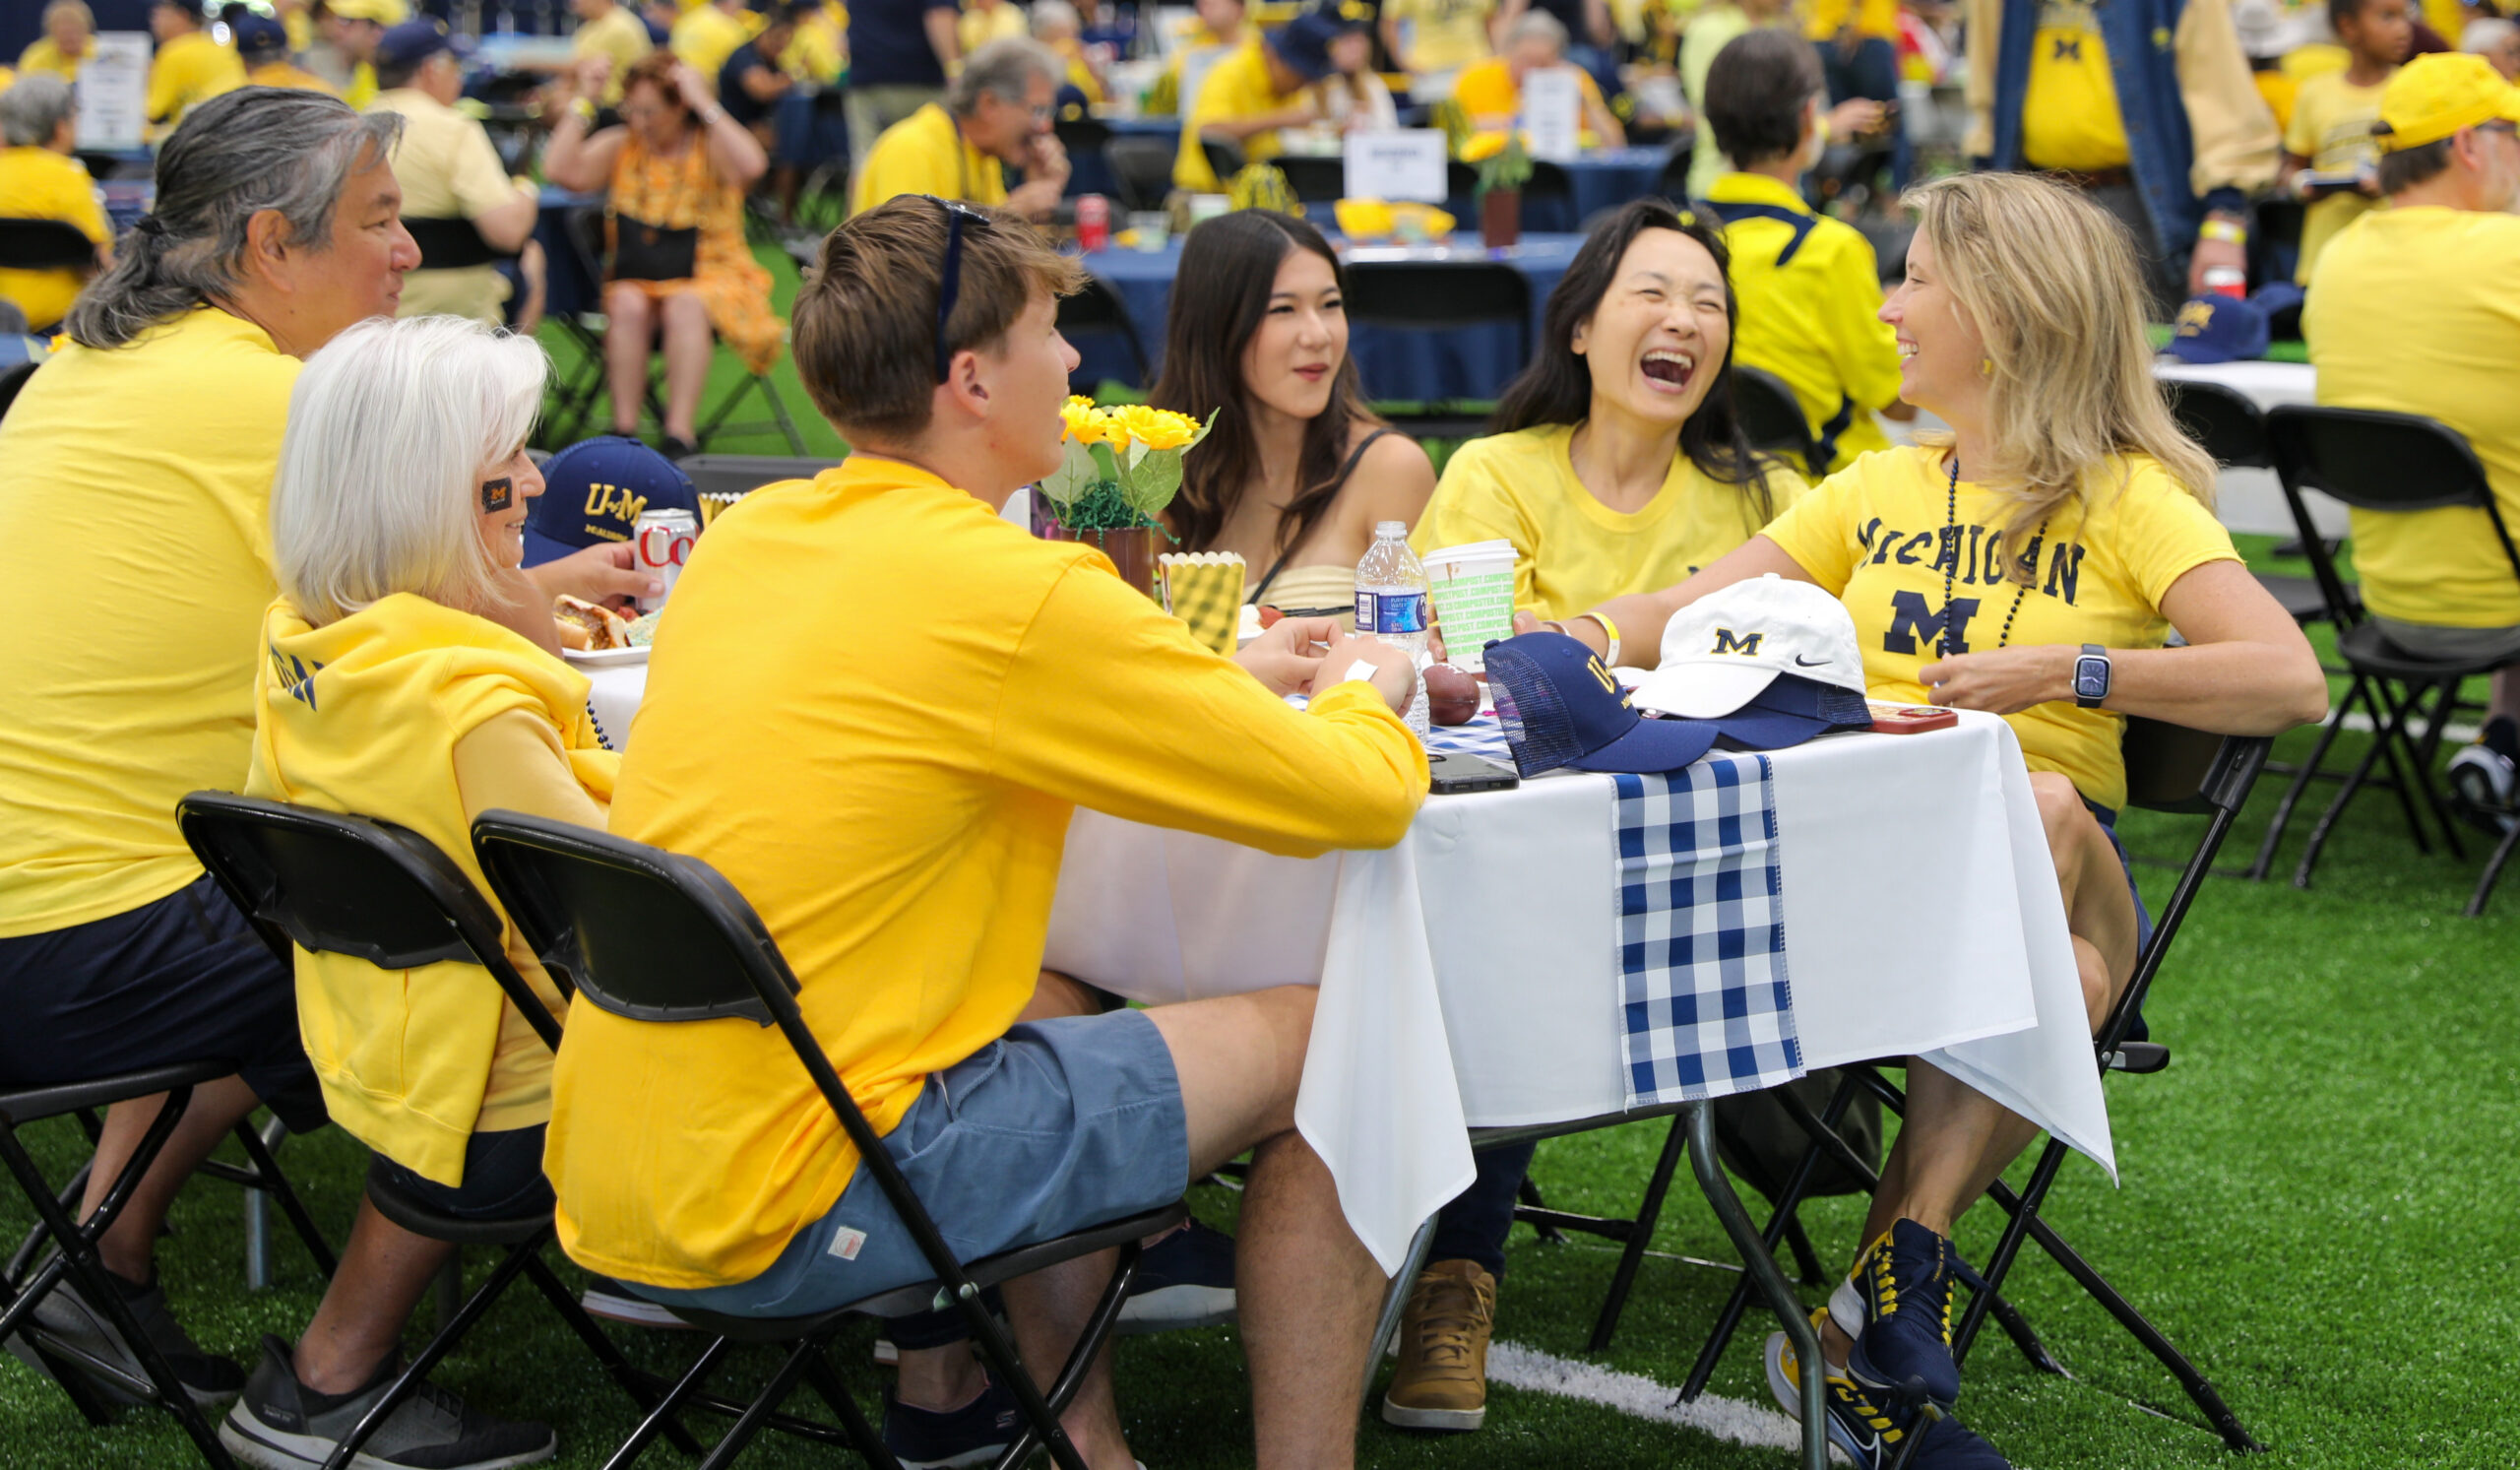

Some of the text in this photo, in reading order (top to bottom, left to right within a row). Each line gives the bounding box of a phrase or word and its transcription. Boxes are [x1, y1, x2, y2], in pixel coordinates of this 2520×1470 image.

[640, 525, 700, 568] Co
[1710, 627, 1764, 657] M
[1883, 590, 1981, 659] M
